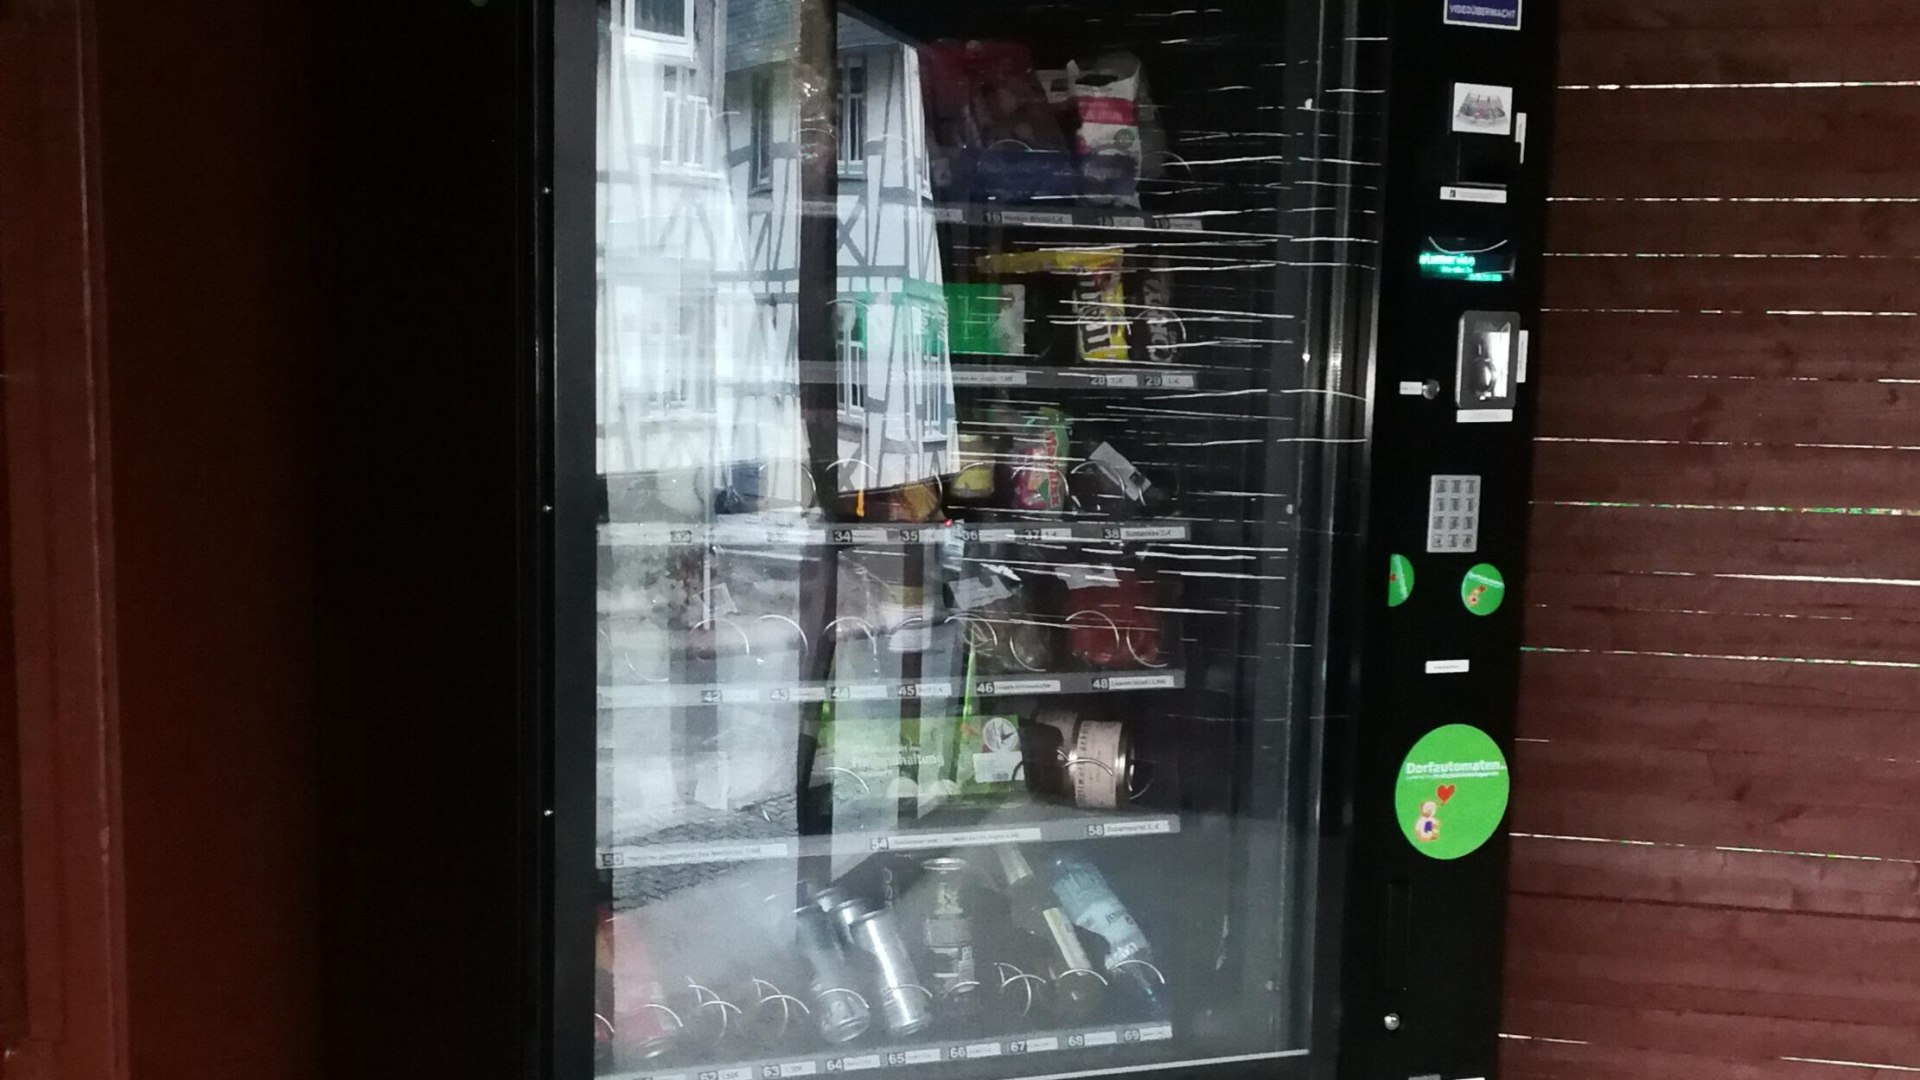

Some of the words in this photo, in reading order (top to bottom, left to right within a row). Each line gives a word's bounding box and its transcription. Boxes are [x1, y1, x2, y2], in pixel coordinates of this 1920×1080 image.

[1146, 375, 1161, 386] 29
[834, 530, 851, 542] 34
[902, 530, 918, 542] 35
[1104, 529, 1120, 539] 38
[976, 681, 993, 694] 46
[1093, 678, 1108, 689] 48
[898, 685, 915, 697] 45
[1088, 825, 1103, 836] 58
[1124, 1030, 1139, 1042] 69
[950, 1046, 966, 1058] 66
[1010, 1041, 1026, 1052] 67
[888, 1053, 905, 1064] 65
[826, 1059, 843, 1070] 64
[763, 1065, 780, 1076] 63
